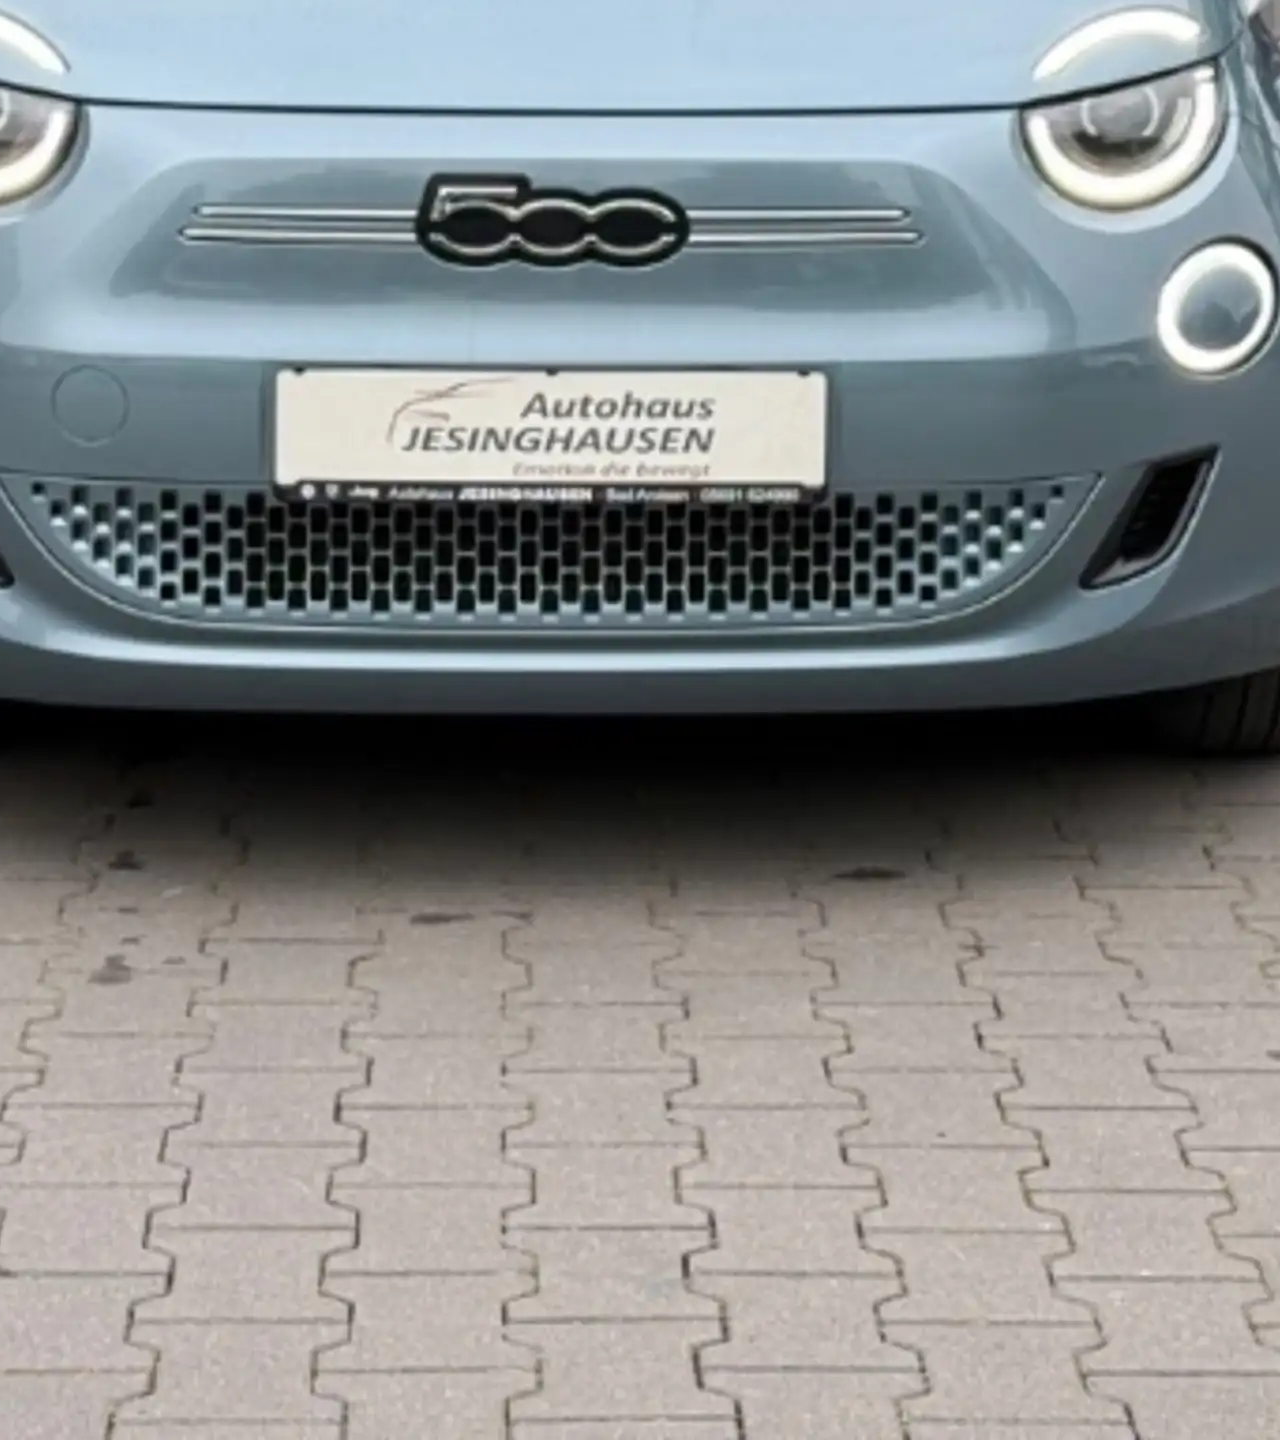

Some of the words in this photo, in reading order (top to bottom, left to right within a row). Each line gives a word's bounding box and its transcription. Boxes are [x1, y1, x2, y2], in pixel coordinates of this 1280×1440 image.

[417, 173, 689, 268] 500
[519, 391, 716, 420] Autohaus
[401, 426, 716, 455] JESINGHAUSEN
